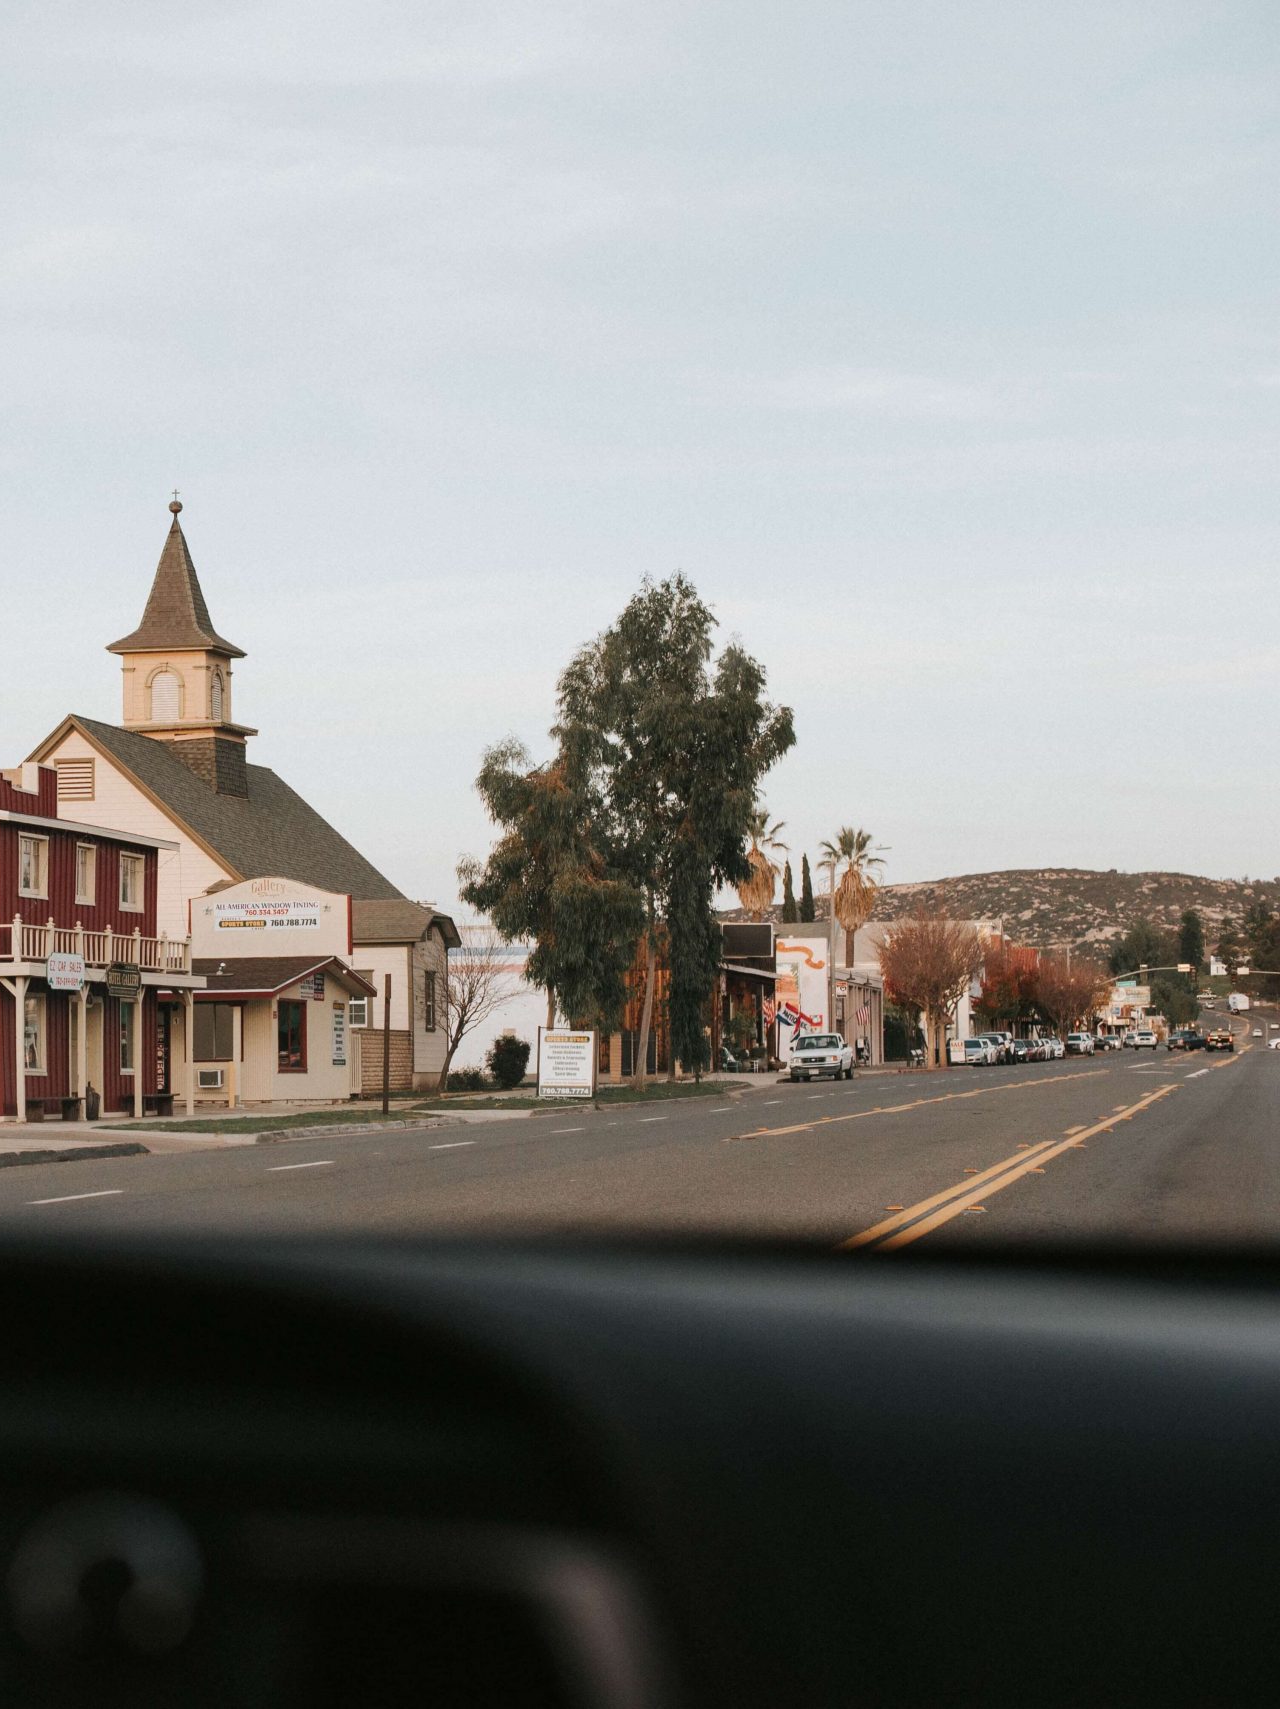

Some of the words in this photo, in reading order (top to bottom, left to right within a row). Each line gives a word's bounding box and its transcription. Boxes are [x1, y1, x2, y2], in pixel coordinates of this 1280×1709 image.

[251, 880, 286, 893] Gallery
[271, 918, 317, 927] 760.788.7774
[49, 960, 56, 972] EZ
[58, 961, 67, 972] CAR
[69, 962, 82, 973] SALES
